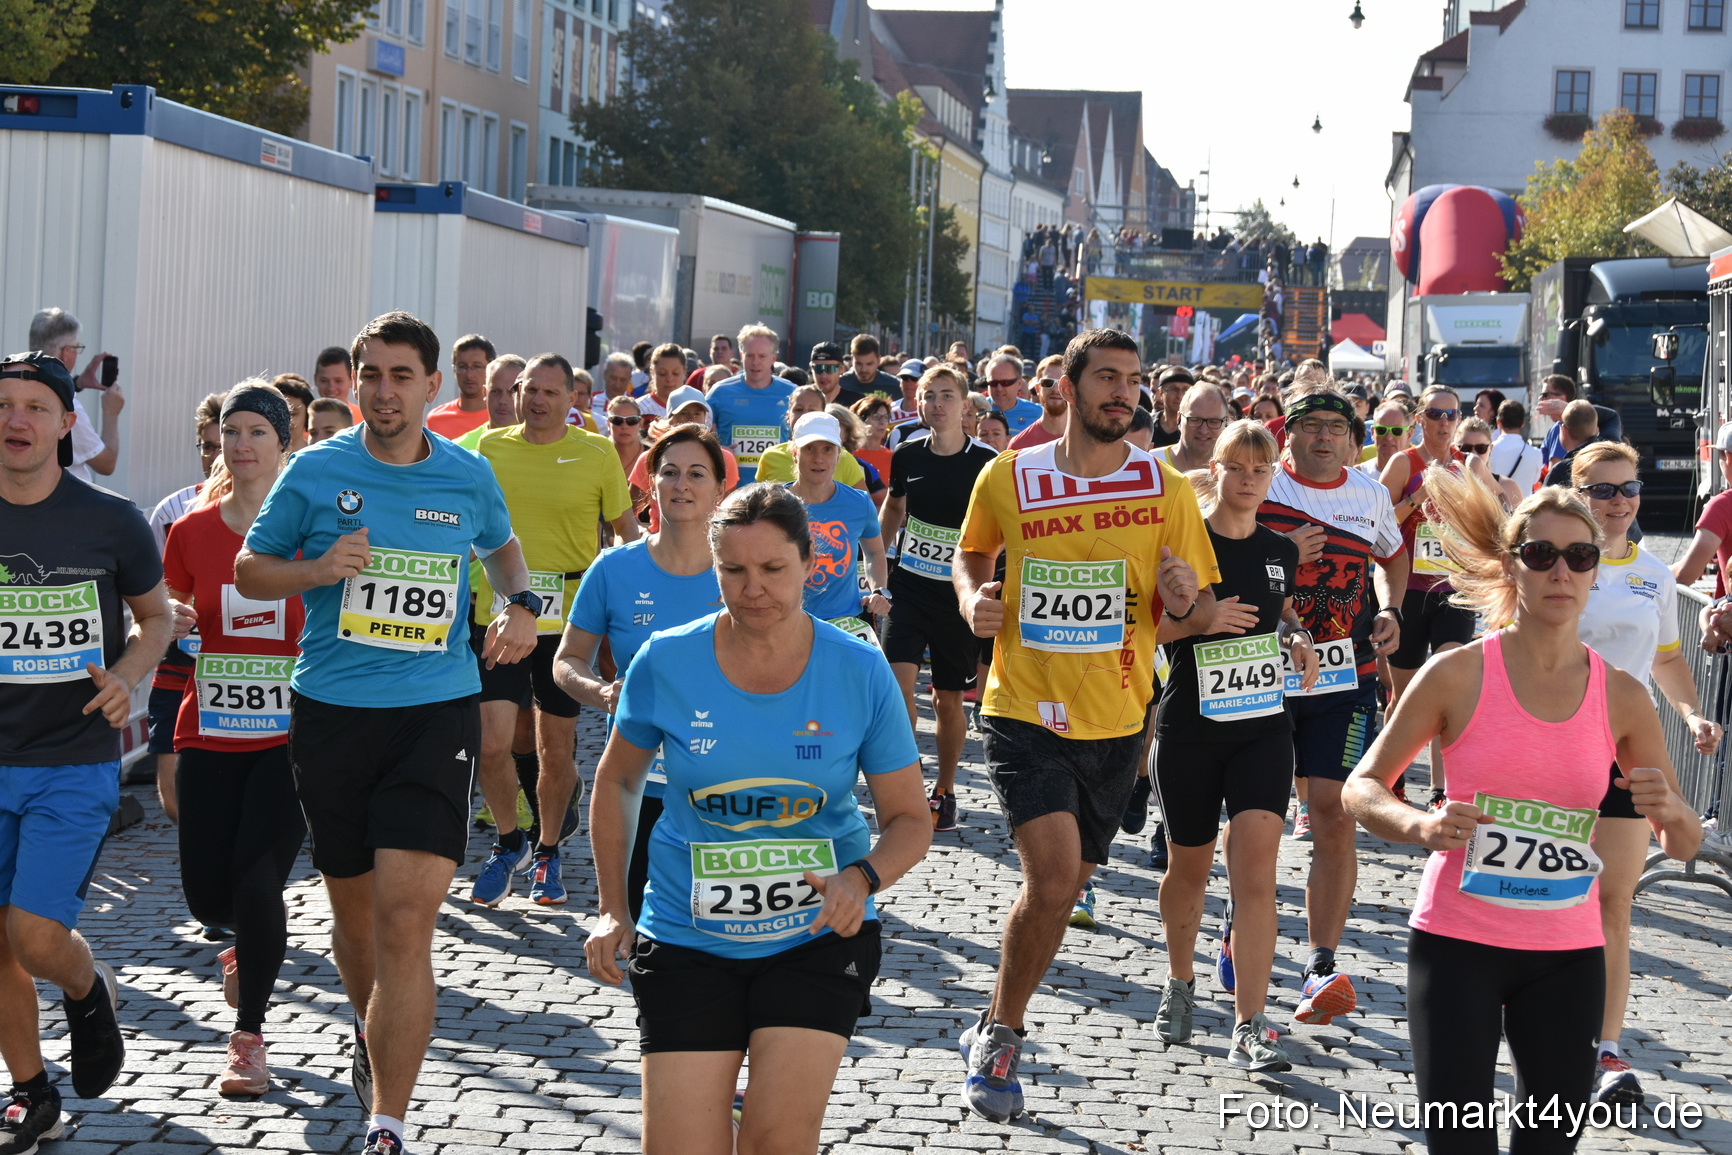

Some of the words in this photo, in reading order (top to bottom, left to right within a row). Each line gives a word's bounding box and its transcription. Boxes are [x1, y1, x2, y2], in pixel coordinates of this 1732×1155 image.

[1143, 285, 1204, 301] START
[736, 427, 776, 438] BOCK
[337, 518, 364, 527] PARTL
[414, 509, 461, 525] BOCK
[1021, 514, 1085, 541] MAX
[1094, 505, 1164, 530] BÖGL
[1332, 513, 1370, 525] NEUMARKT
[911, 520, 960, 541] BOCK
[908, 538, 955, 563] 2622
[914, 560, 942, 574] LOUIS
[1029, 563, 1117, 586] BOCK
[0, 588, 89, 611] BOCK
[360, 582, 446, 618] 1189
[1031, 592, 1112, 621] 2402
[243, 615, 264, 625] DEHN
[0, 618, 91, 649] 2438
[369, 621, 426, 640] PETER
[1043, 629, 1098, 643] JOVAN
[1204, 637, 1274, 664] BOCK
[13, 655, 81, 672] ROBERT
[203, 658, 289, 678] BOCK
[1209, 662, 1276, 695] 2449
[1286, 673, 1338, 688] CHRLY
[208, 683, 282, 710] 2581
[1209, 692, 1278, 710] MARIE-CLAIRE
[218, 716, 278, 730] MARINA
[691, 720, 713, 728] erima
[1482, 797, 1585, 838] BOCK
[700, 845, 823, 874] BOCK
[1482, 831, 1589, 873] 2788
[710, 878, 821, 916] 2362
[1499, 879, 1551, 897] Marlene
[724, 912, 809, 934] MARGIT
